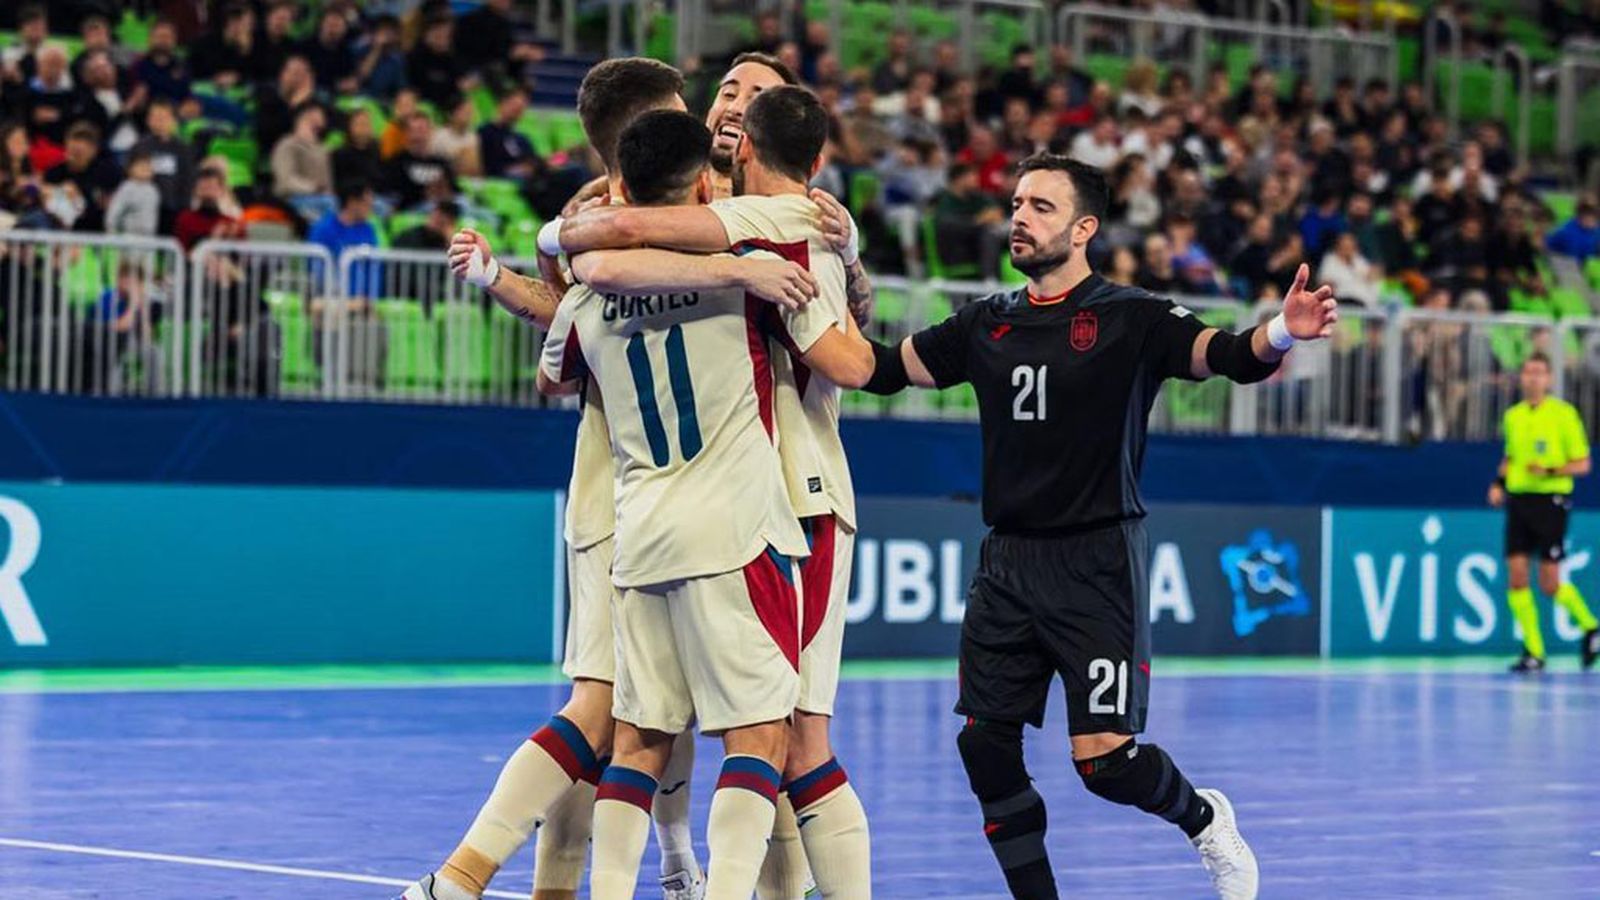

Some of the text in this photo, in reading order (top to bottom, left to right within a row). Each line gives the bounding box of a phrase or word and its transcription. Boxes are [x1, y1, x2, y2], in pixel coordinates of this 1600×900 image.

[626, 323, 703, 468] 11
[1011, 364, 1047, 420] 21
[1354, 515, 1591, 643] vist
[1088, 658, 1127, 715] 21
